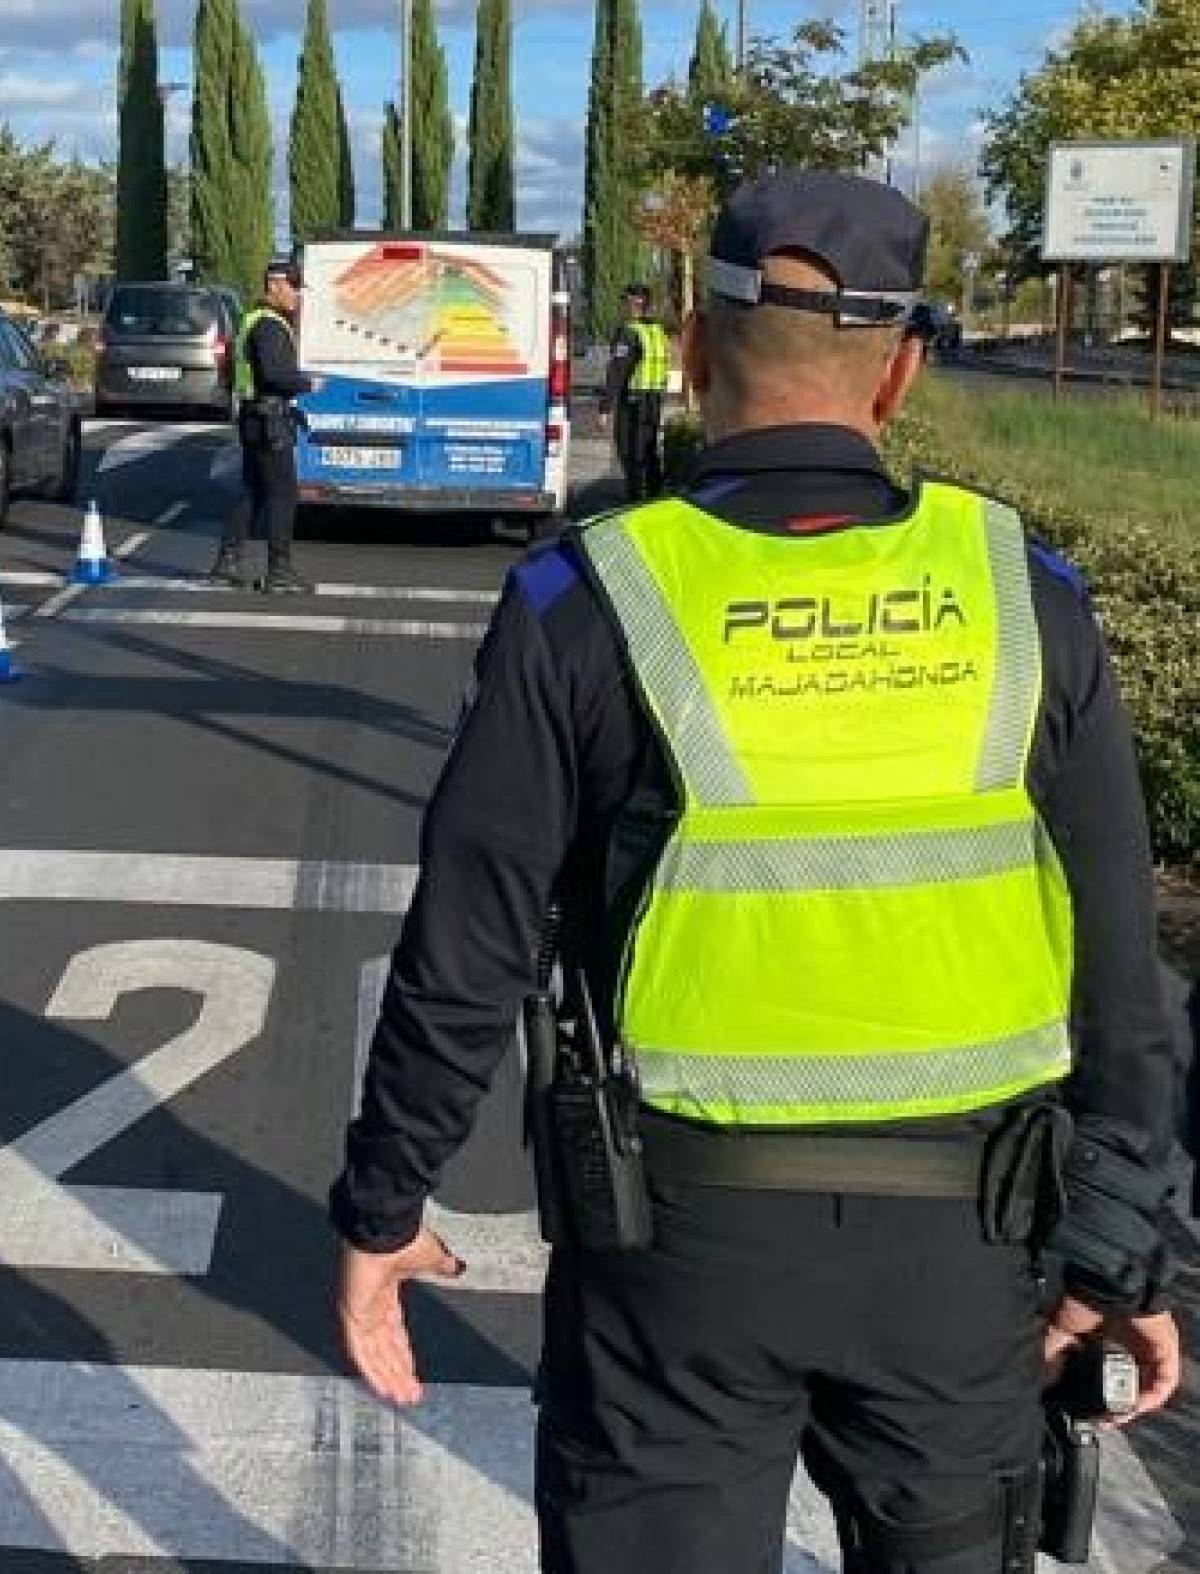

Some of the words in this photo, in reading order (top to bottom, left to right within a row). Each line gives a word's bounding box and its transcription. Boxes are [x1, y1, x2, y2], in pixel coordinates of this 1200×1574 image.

[722, 572, 967, 643] POLICÍA
[786, 640, 902, 663] LOCAL
[727, 662, 979, 698] MAJADAHONDA
